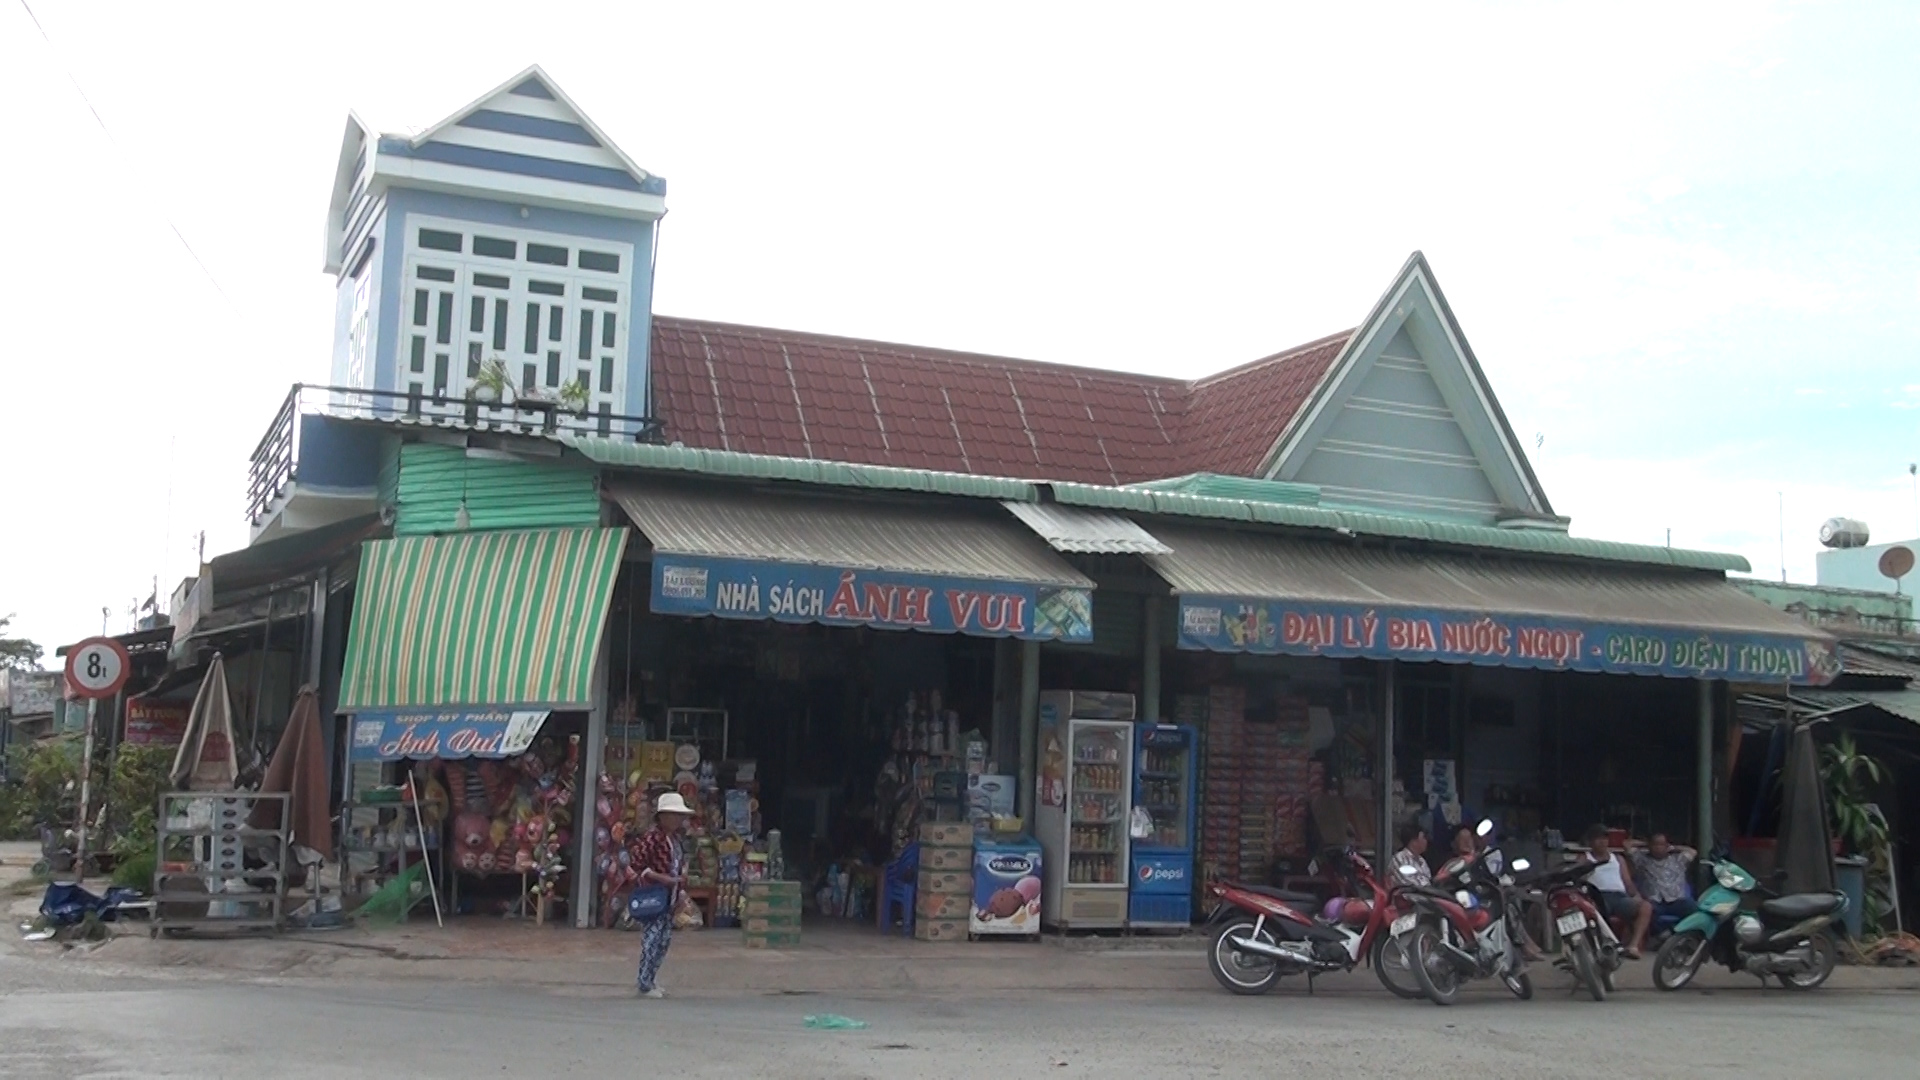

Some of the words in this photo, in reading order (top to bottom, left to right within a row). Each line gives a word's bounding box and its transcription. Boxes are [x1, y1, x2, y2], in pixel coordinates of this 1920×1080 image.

[716, 575, 761, 612] NHÀ
[768, 579, 824, 616] SÁCH
[825, 569, 932, 626] ÁNH
[944, 590, 1026, 634] VUI
[1283, 611, 1335, 651] ĐẠI
[1341, 609, 1379, 648] LÝ
[1387, 617, 1437, 651] BIA
[1441, 617, 1512, 657] NƯỚC
[1517, 625, 1584, 666] NGỌT
[1605, 632, 1666, 665] CARD
[1671, 634, 1729, 676] ĐIỆN
[1154, 866, 1184, 880] pepsi
